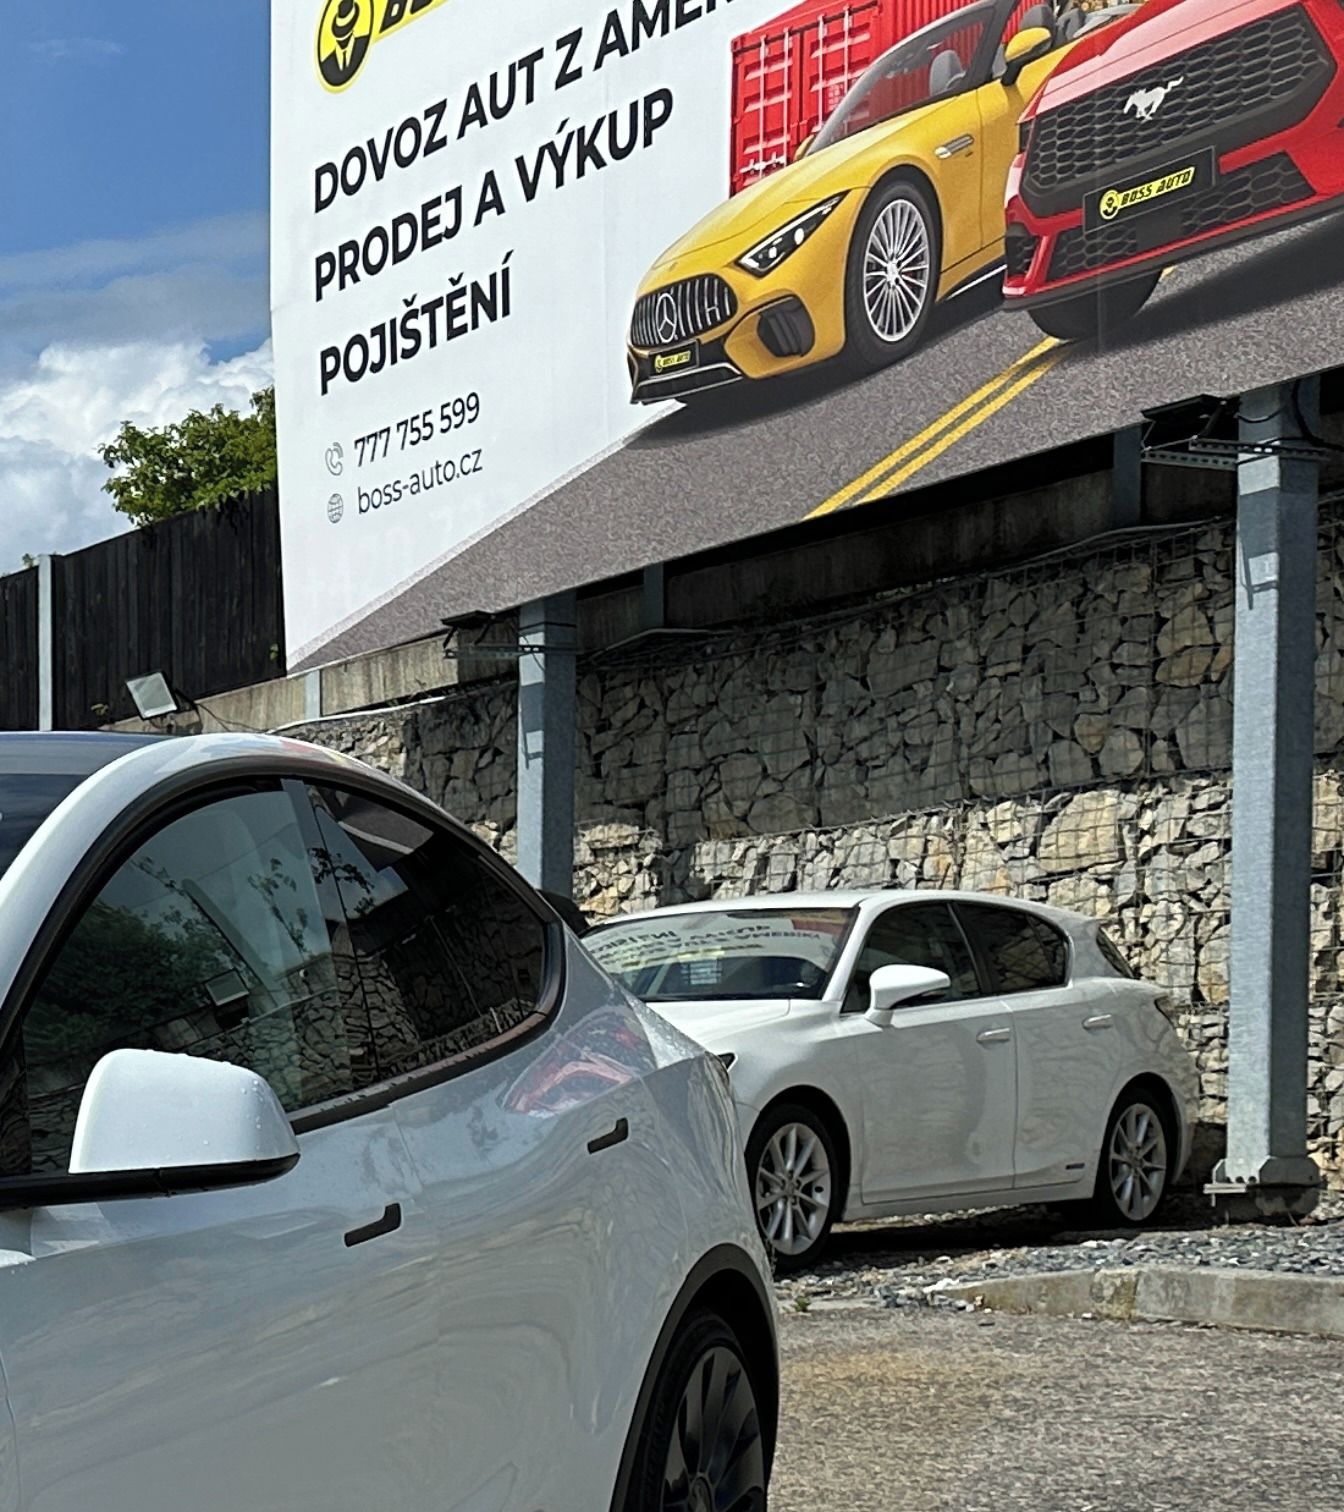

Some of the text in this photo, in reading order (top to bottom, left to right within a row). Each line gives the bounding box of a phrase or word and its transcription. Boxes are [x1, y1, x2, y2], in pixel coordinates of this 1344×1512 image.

[314, 0, 732, 213] DOVOZ AUT Z AME
[315, 87, 674, 301] PRODEJ A VÝKUP
[1121, 170, 1191, 206] BOSS AUTO
[320, 249, 514, 396] POJIŠTĚNÍ
[354, 392, 481, 467] 777 755 599
[358, 448, 483, 515] boss-auto.cz
